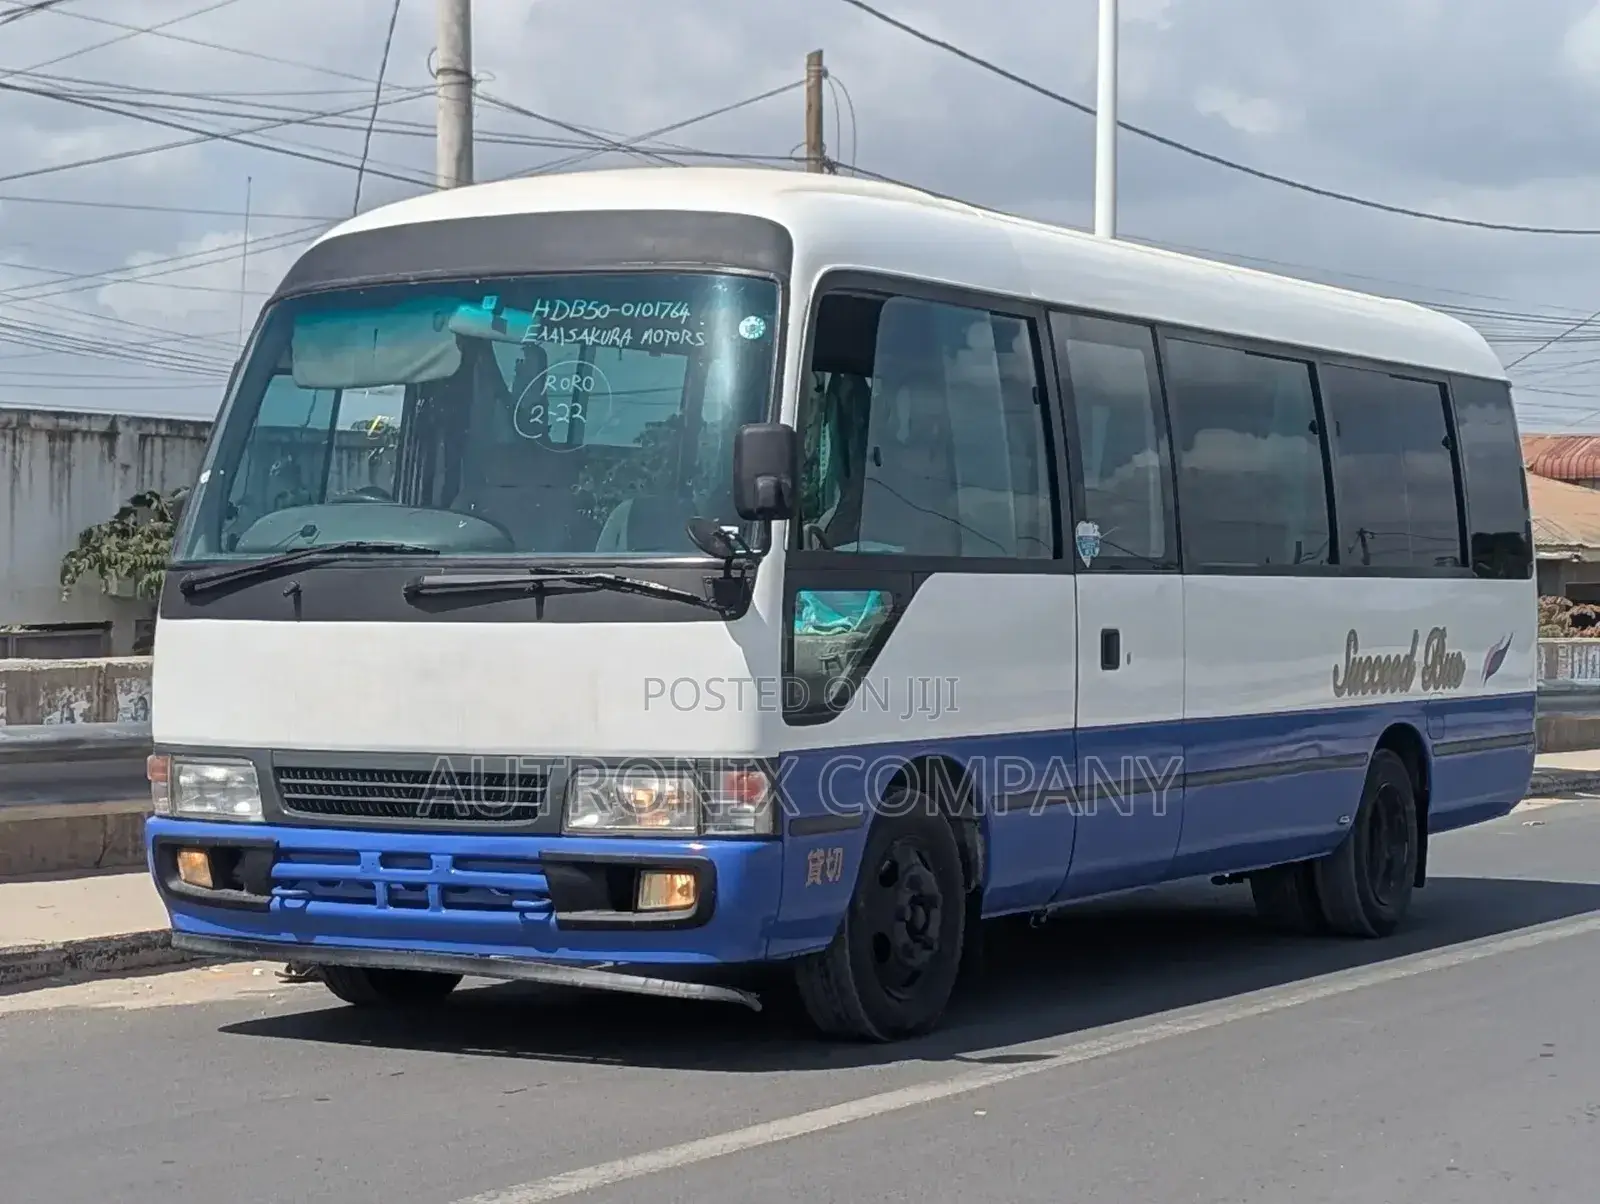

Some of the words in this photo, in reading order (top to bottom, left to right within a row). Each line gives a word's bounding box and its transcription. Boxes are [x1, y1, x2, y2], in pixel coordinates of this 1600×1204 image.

[531, 299, 691, 324] HDB50-0101764
[640, 328, 704, 347] MOTORS
[541, 375, 595, 396] RORO
[529, 403, 587, 424] 2-22
[1333, 628, 1420, 698] Succeed
